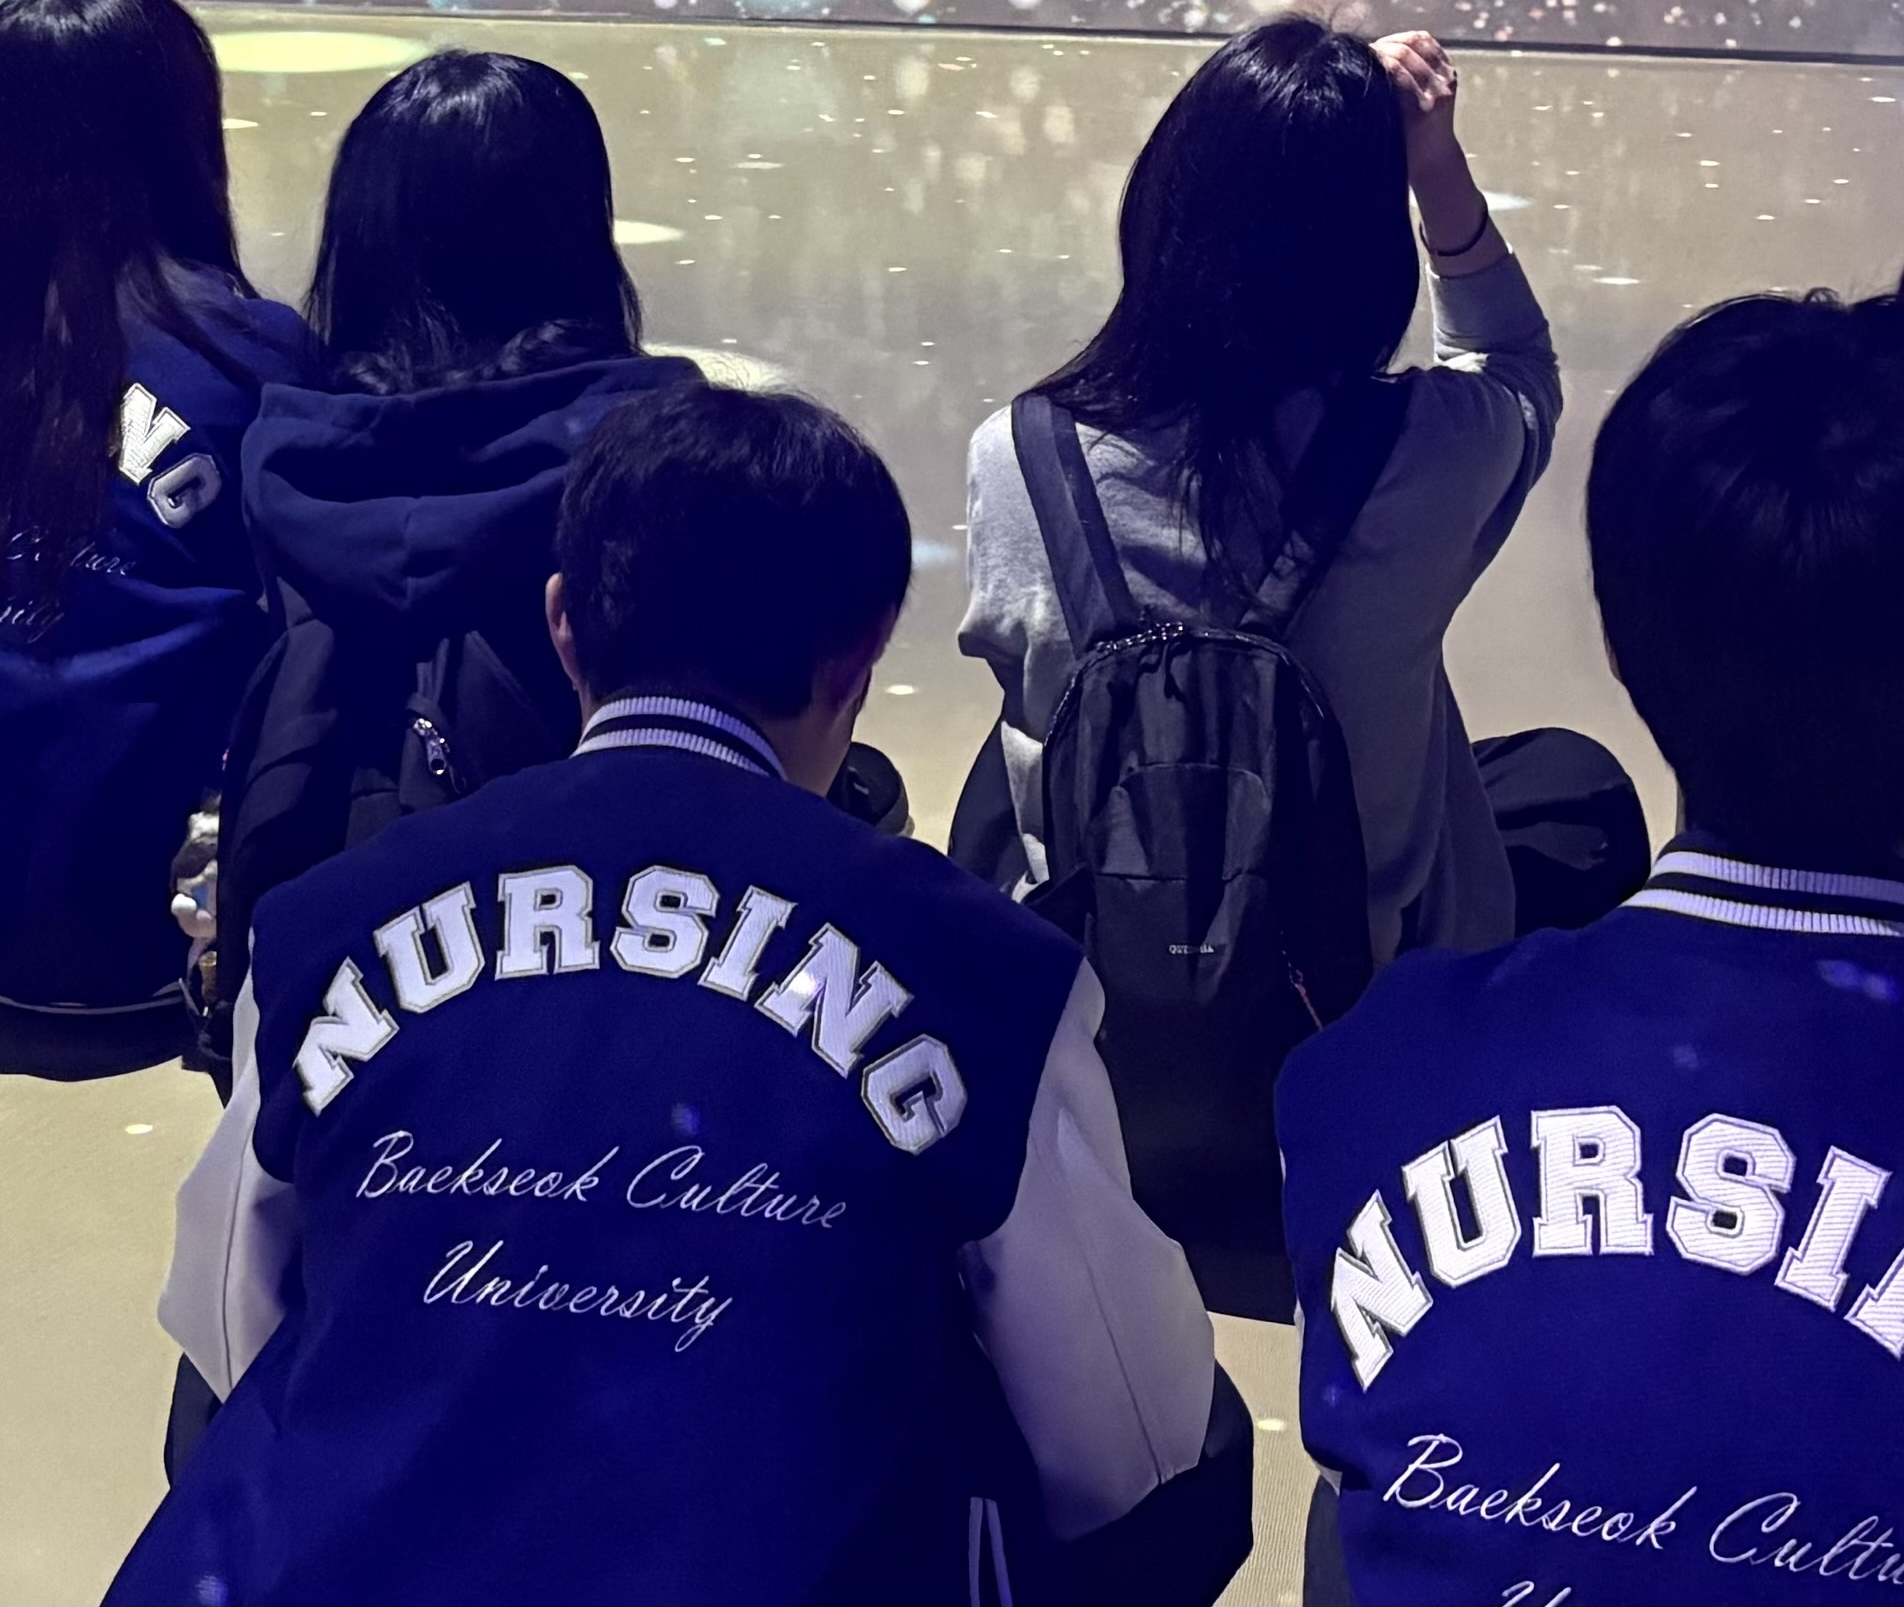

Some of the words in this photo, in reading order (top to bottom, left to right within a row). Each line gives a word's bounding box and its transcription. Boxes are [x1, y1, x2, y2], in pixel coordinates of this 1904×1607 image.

[296, 864, 967, 1155] NURSING
[355, 1130, 619, 1202] Baekseok
[626, 1145, 846, 1228] Culture
[423, 1239, 733, 1352] University
[1382, 1433, 1697, 1550] Baekseok
